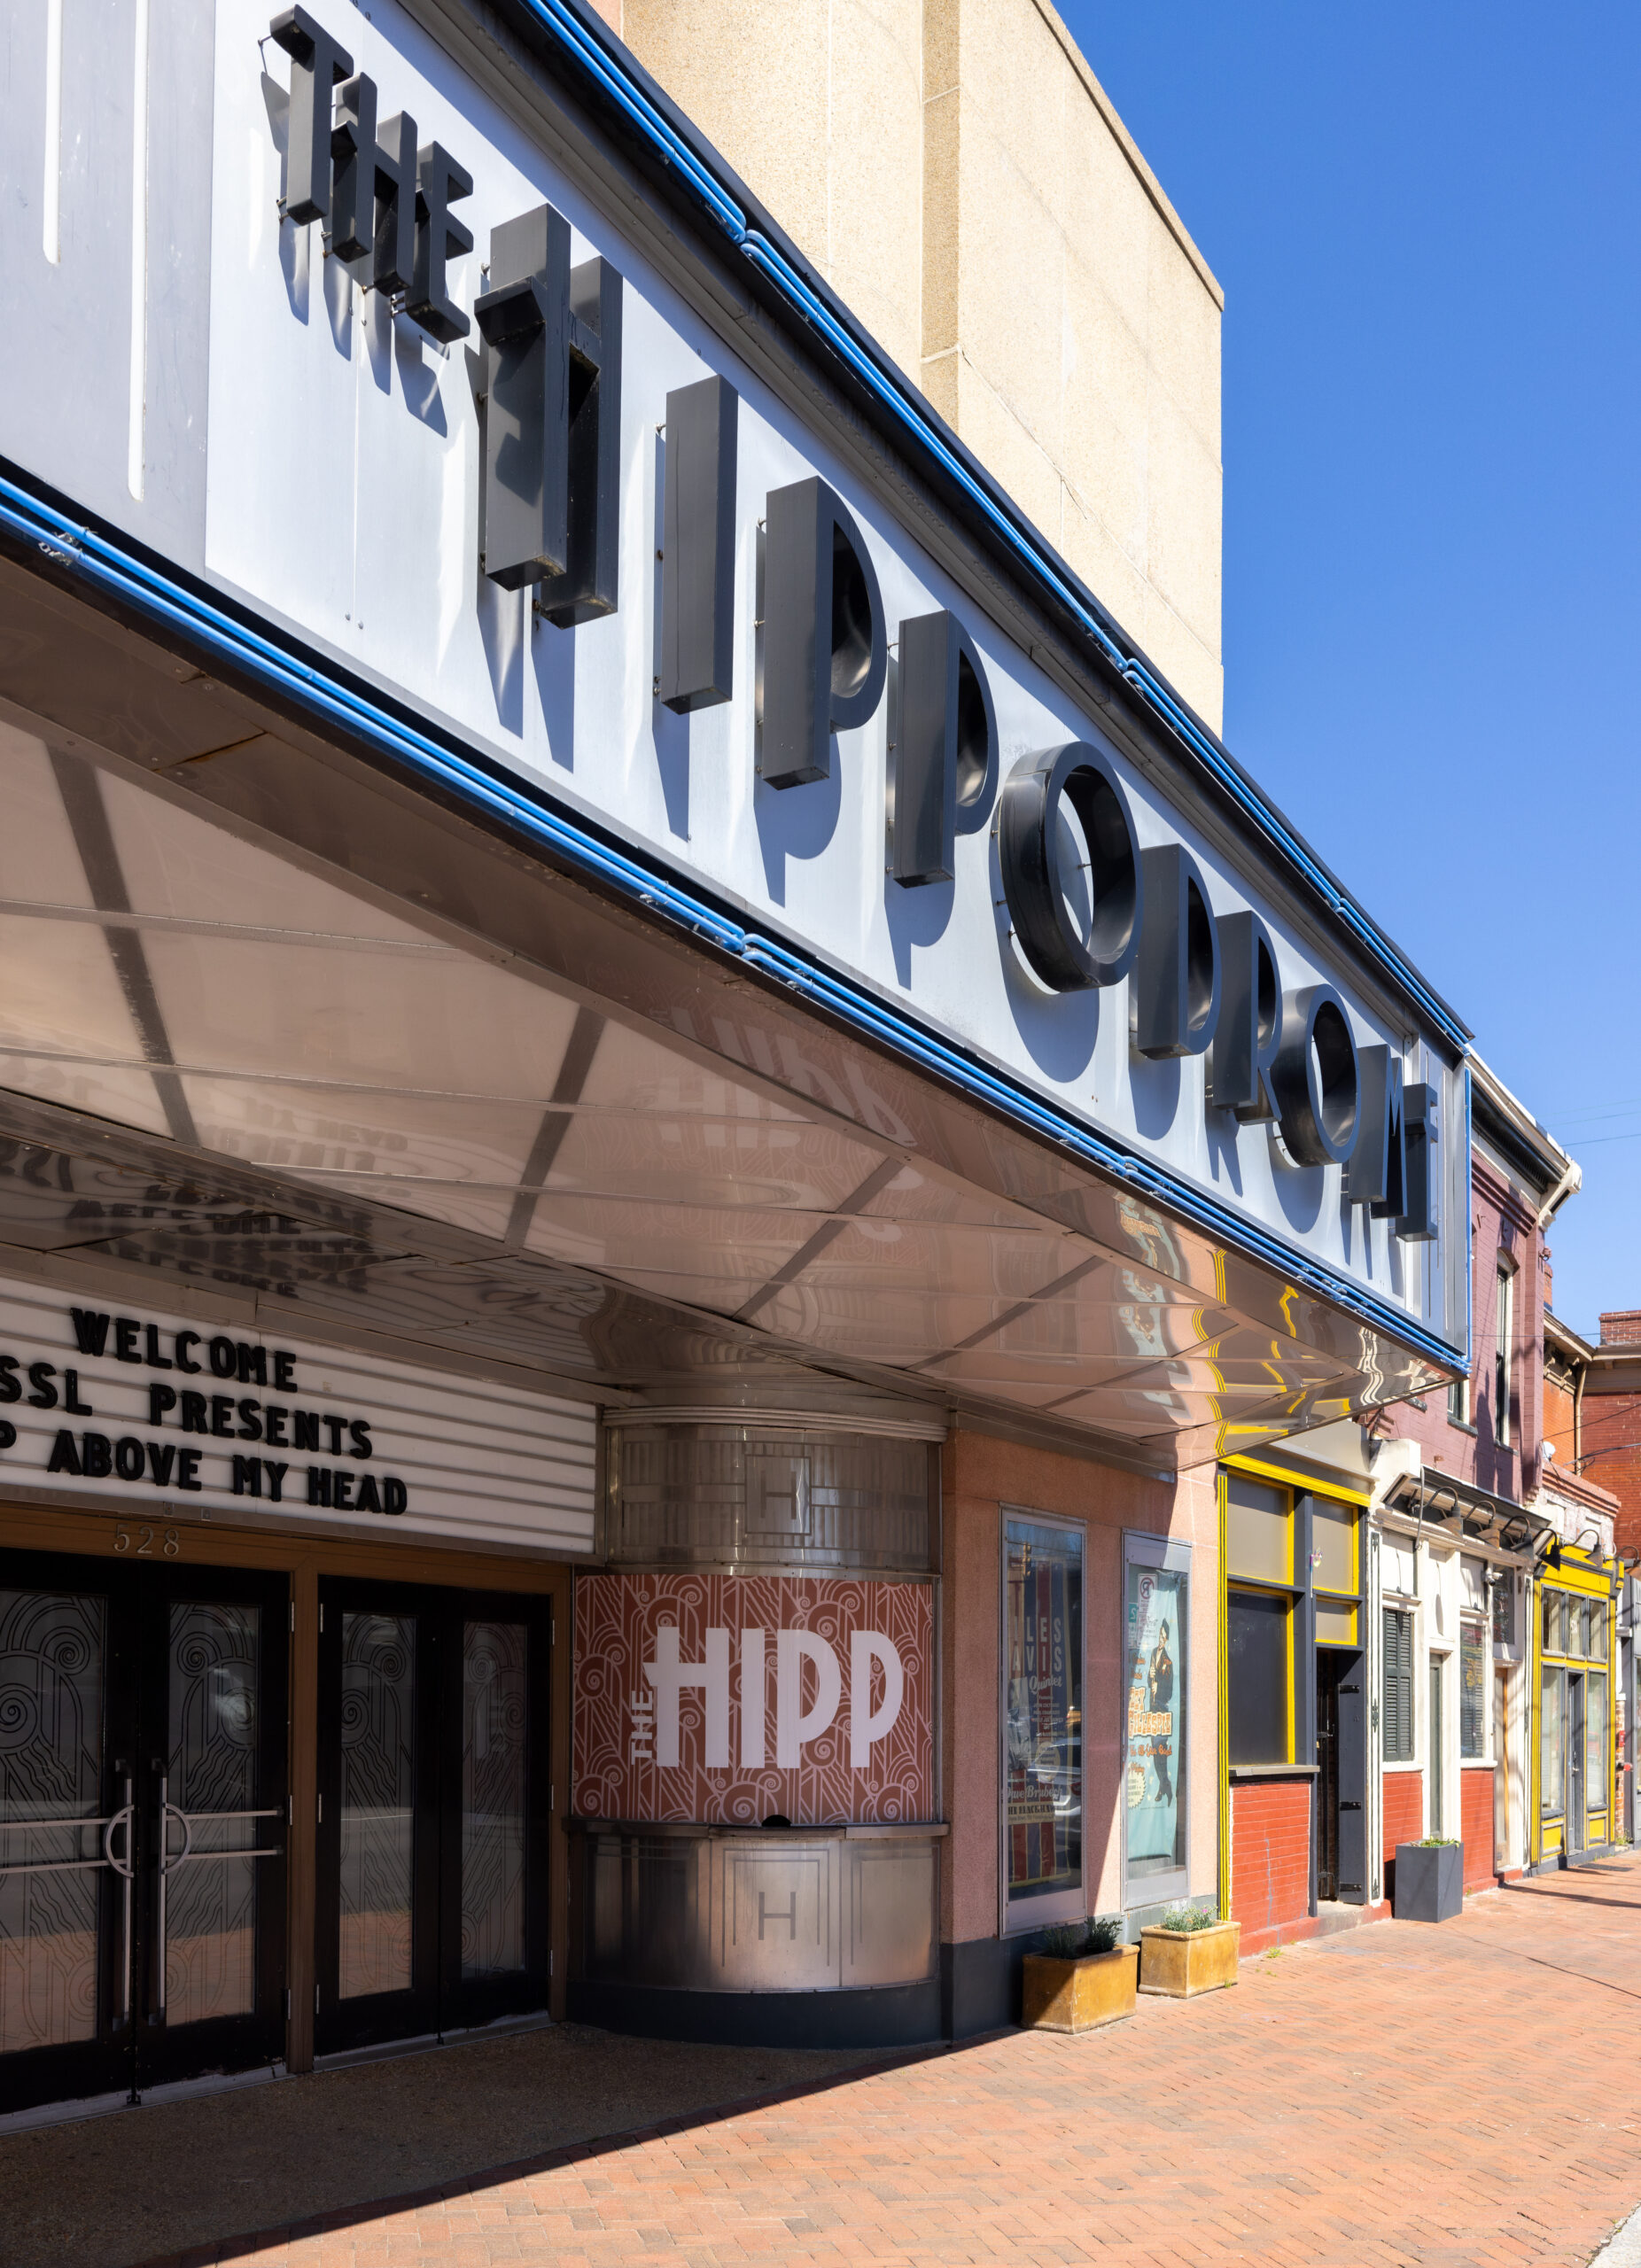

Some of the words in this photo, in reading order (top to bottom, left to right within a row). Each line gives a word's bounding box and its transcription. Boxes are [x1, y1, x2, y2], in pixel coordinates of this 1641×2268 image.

[269, 4, 473, 344] THE
[475, 203, 1438, 1241] HIPPODROME
[70, 1308, 298, 1393] WELCOME
[150, 1384, 373, 1460] PRESENTS
[48, 1430, 202, 1491] ABOVE
[233, 1455, 289, 1502] MY
[307, 1466, 408, 1515] HEAD
[113, 1524, 179, 1556] 528
[1012, 1645, 1062, 1673] AVIS
[1014, 1616, 1062, 1643] ILES
[630, 1689, 654, 1765] THE
[643, 1627, 904, 1768] HIPP
[758, 1891, 797, 1940] H
